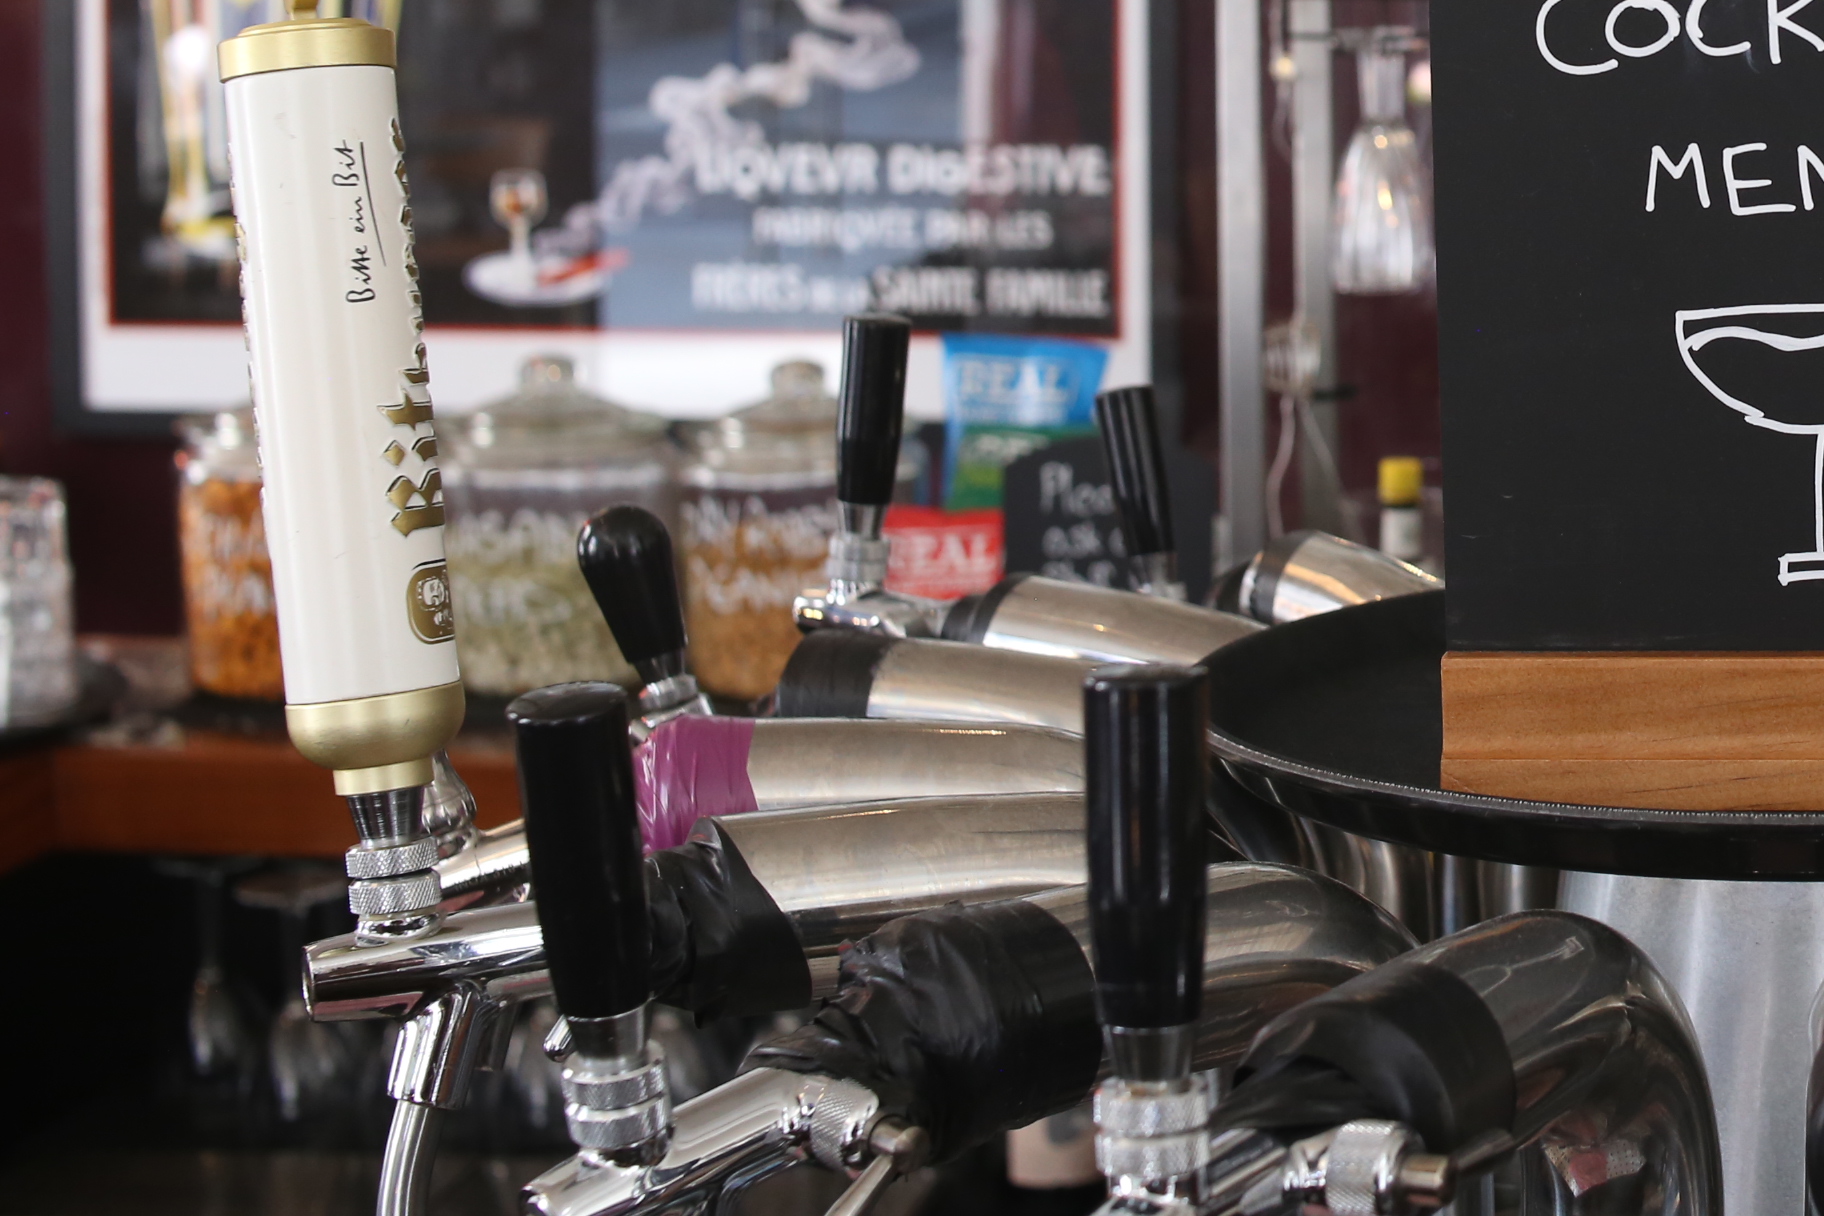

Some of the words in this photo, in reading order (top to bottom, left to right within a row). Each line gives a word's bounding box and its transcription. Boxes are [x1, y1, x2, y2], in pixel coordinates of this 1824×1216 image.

[332, 139, 360, 187] Bit
[887, 143, 1111, 195] DIGESTIVE
[349, 196, 366, 234] ein
[345, 245, 376, 303] Bitte
[958, 358, 1070, 405] REAL
